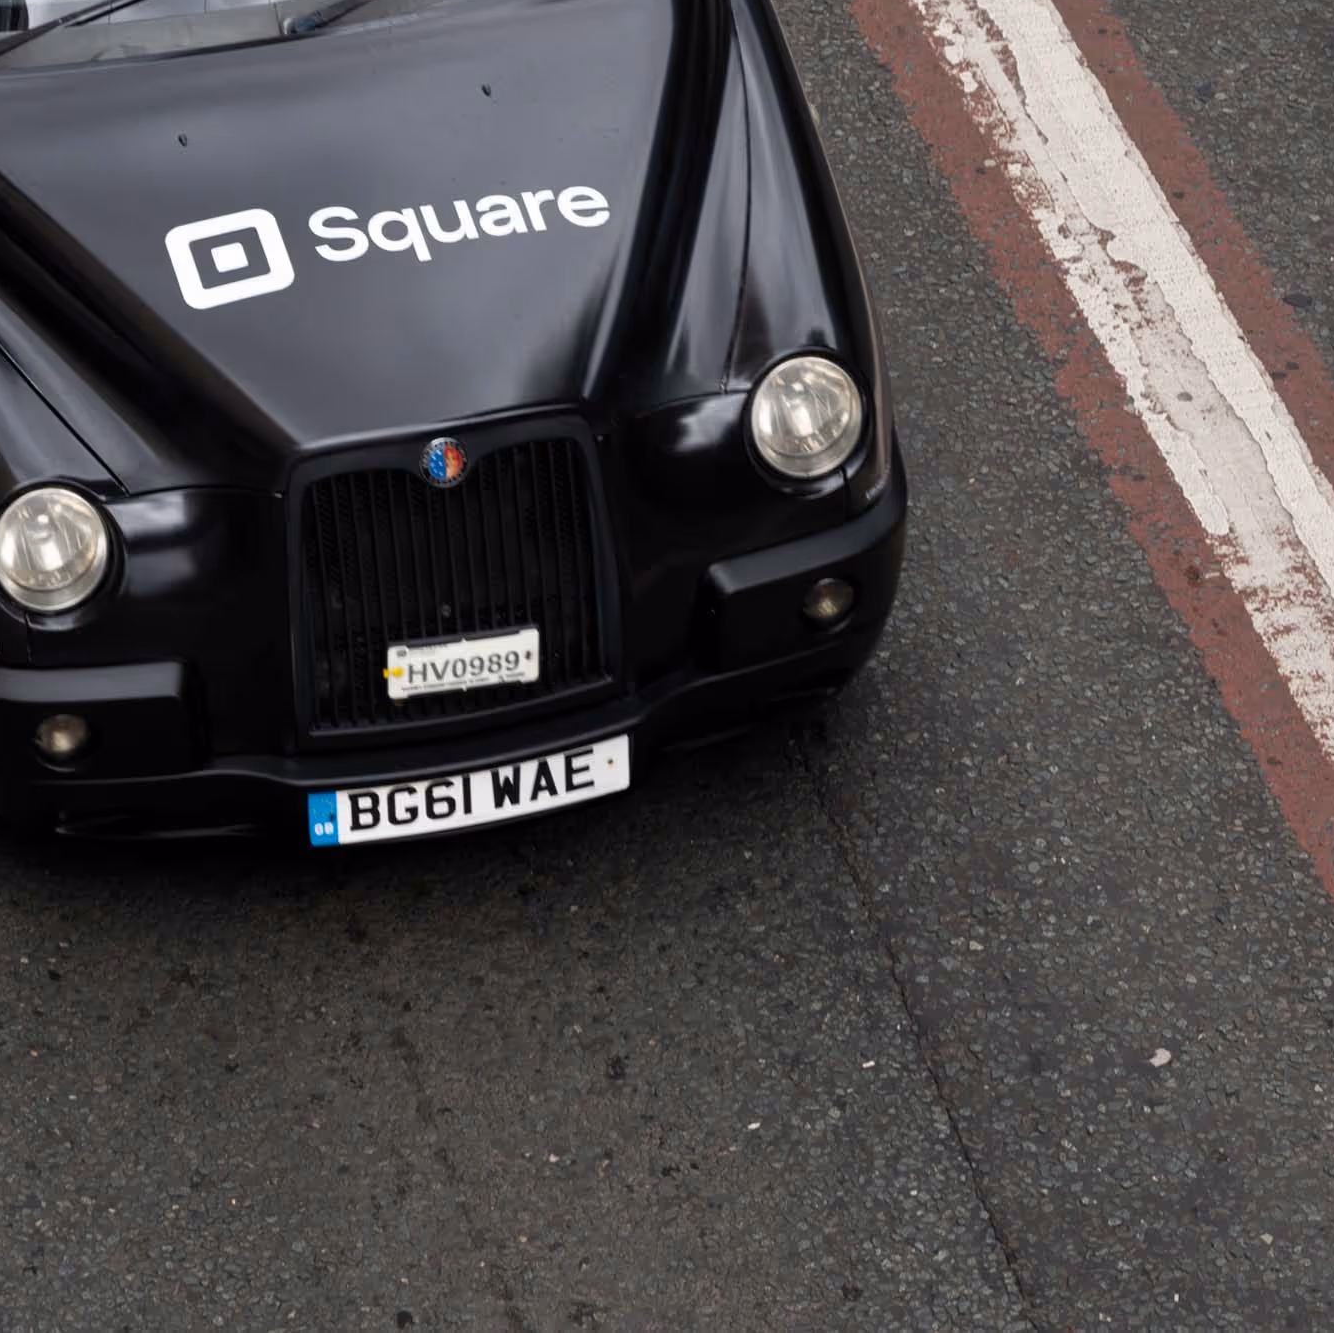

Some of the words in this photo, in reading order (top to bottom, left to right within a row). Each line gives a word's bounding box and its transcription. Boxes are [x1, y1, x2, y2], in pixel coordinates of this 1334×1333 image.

[308, 185, 610, 262] Square
[407, 650, 520, 683] HV0989
[348, 774, 472, 832] BG61
[491, 747, 595, 809] WAE
